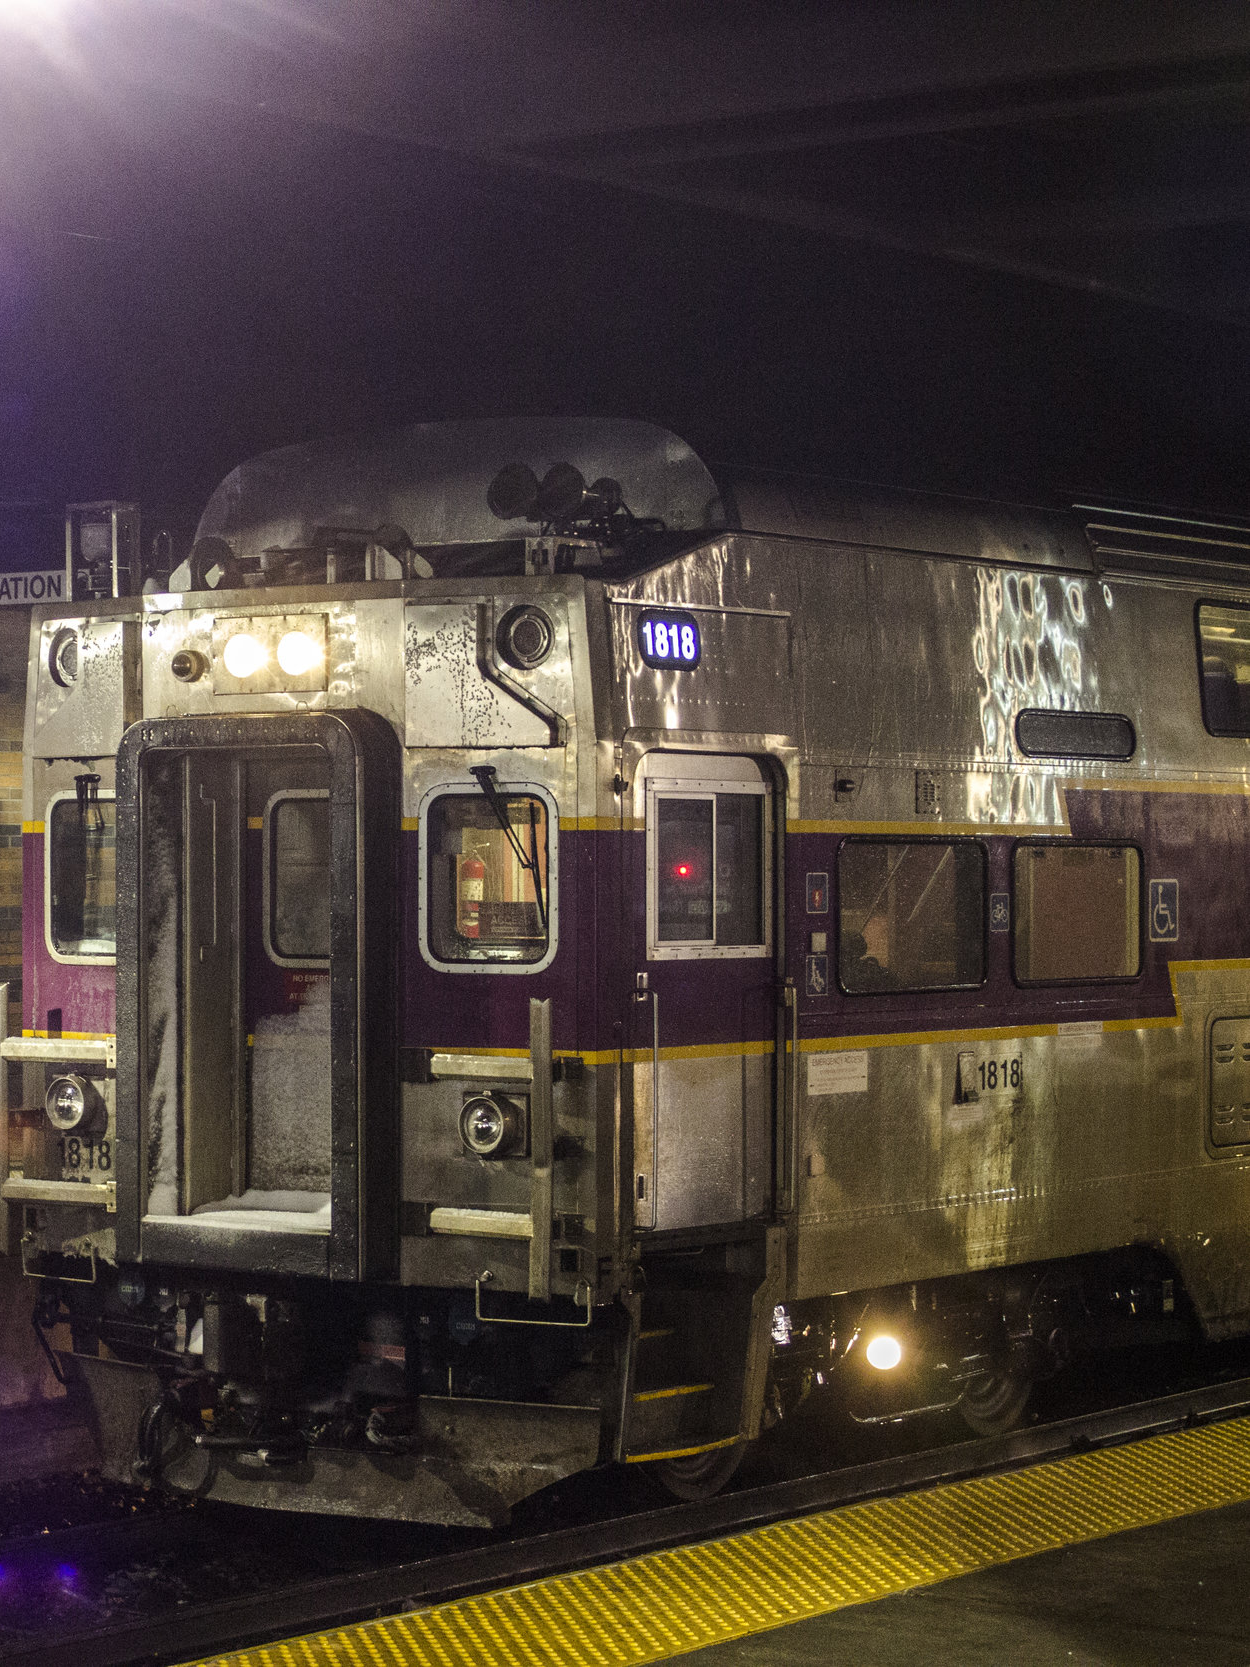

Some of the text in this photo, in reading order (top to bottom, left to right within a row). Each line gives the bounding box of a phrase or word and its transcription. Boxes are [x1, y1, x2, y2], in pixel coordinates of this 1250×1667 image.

[642, 621, 695, 659] 1818
[978, 1058, 1020, 1090] 1818
[57, 1137, 111, 1170] 1818
